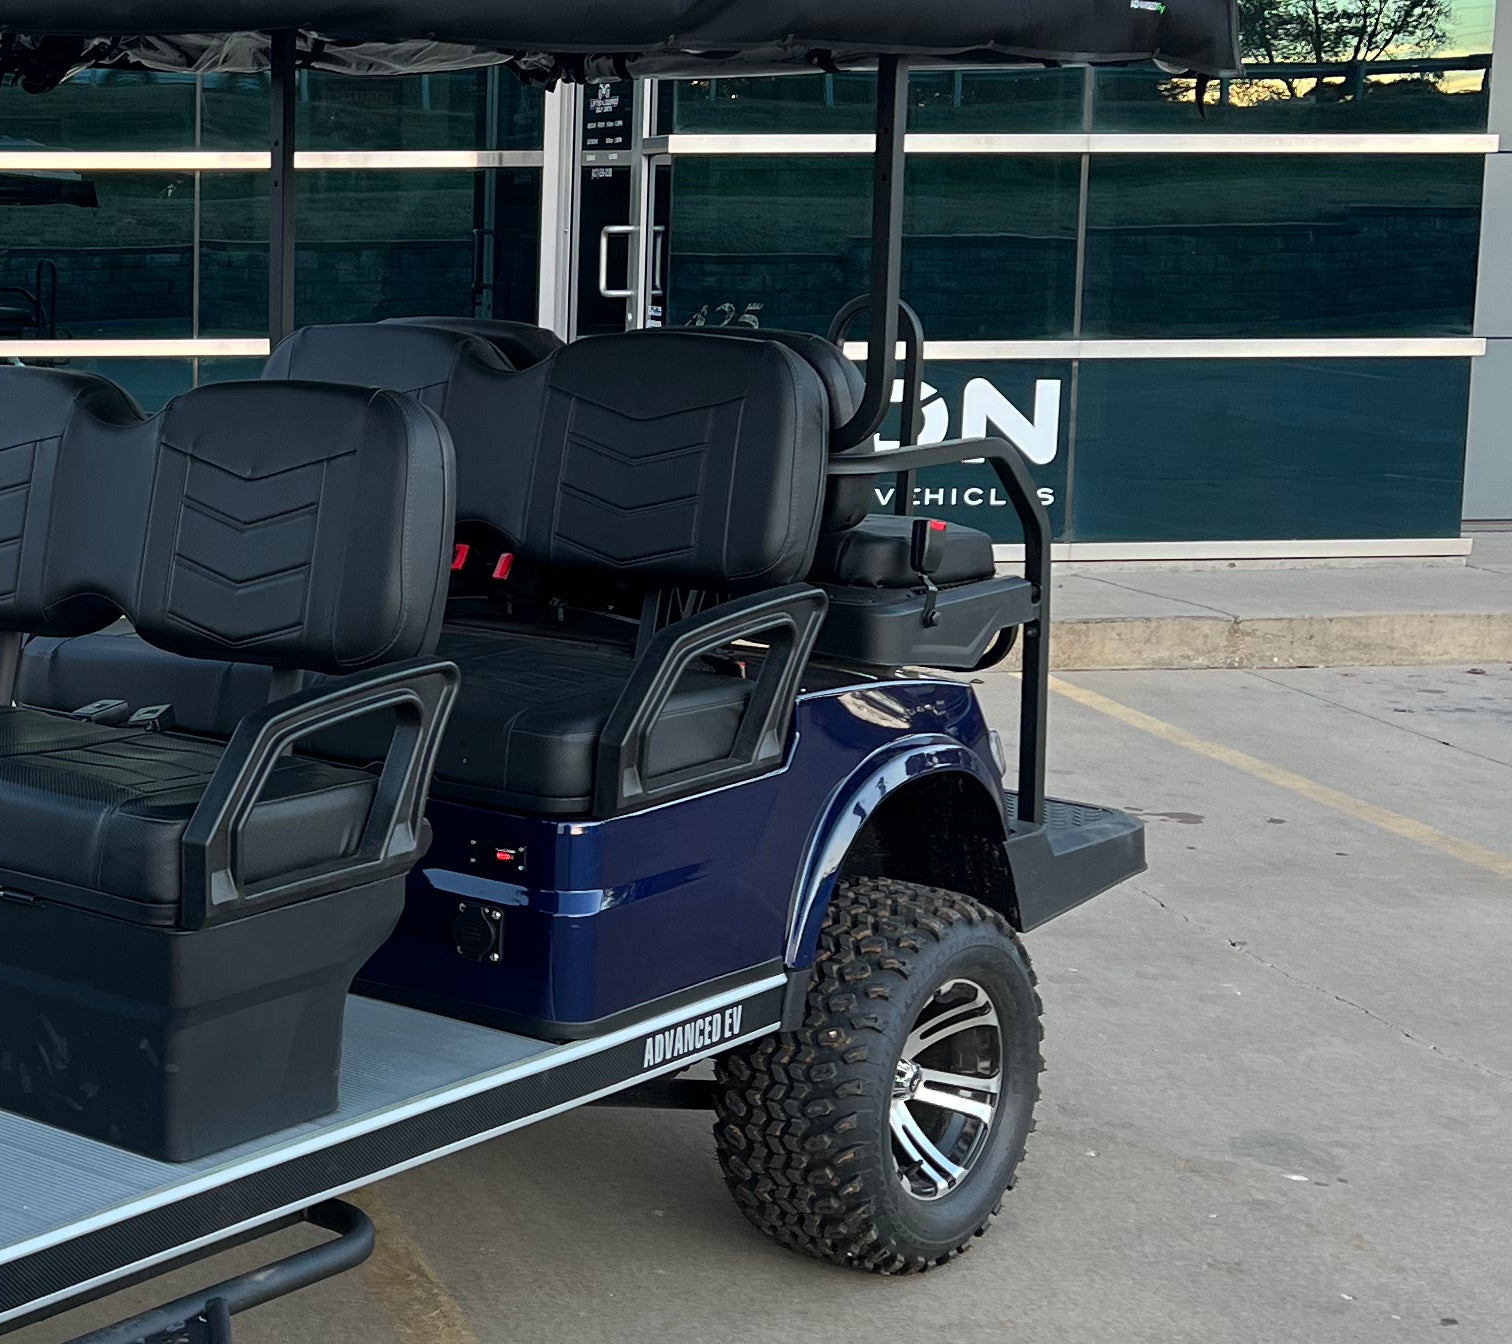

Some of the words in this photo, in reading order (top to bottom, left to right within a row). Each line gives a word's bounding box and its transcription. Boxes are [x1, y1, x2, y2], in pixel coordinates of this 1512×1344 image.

[874, 487, 1055, 506] VEHICLS
[643, 1012, 723, 1069] ADVANCED
[724, 1004, 744, 1039] EV
